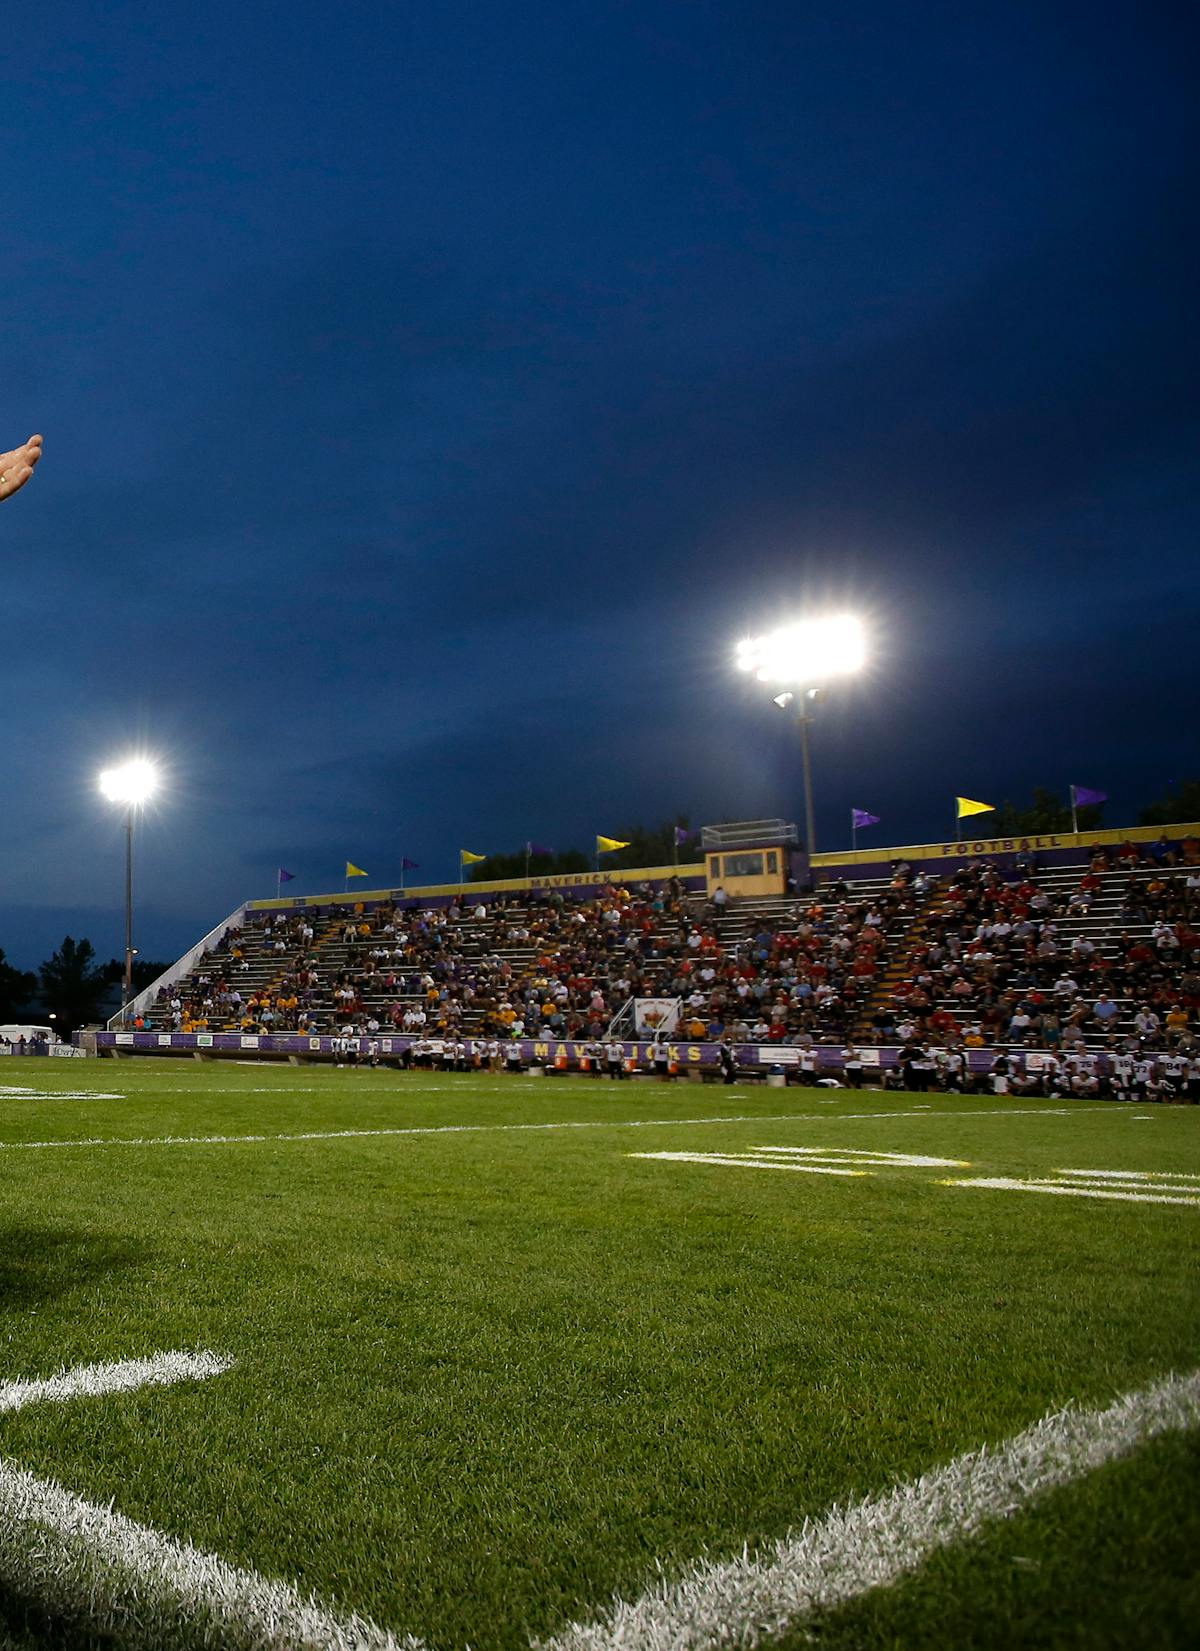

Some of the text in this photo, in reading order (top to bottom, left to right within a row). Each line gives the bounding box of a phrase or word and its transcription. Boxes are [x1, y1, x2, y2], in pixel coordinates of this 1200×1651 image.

[942, 836, 1062, 856] FOOTBALL
[531, 873, 612, 888] MAVERICK
[1167, 1062, 1180, 1070] 84
